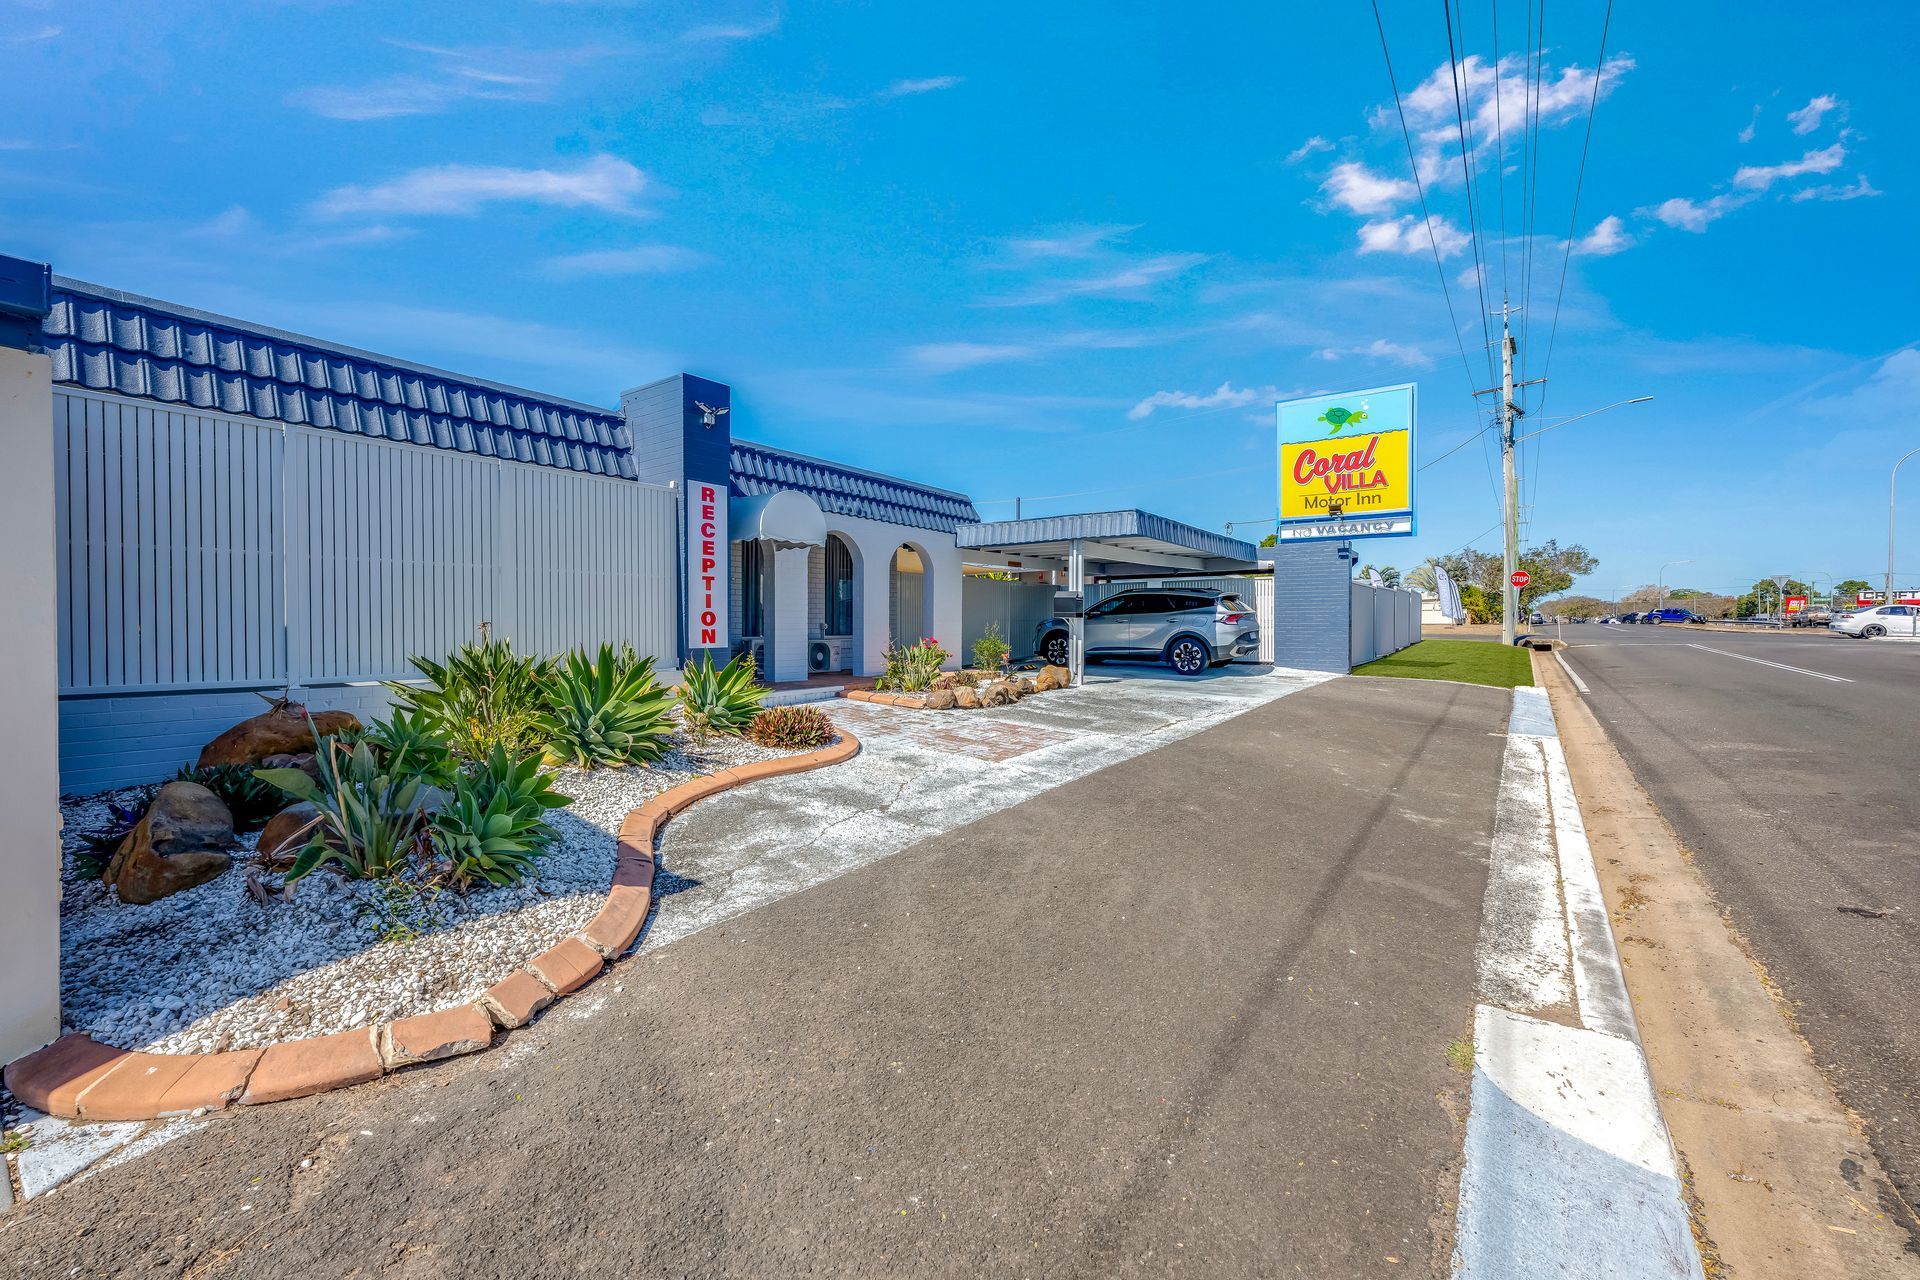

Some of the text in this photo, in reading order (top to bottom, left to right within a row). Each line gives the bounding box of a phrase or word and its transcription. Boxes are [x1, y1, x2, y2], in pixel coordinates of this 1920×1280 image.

[1293, 435, 1380, 485] Coral
[1323, 469, 1389, 495] VILLA
[1304, 492, 1382, 509] Motor Inn
[1317, 520, 1395, 536] VACANCY
[701, 486, 716, 644] RECEPTION
[1511, 575, 1528, 583] STOP
